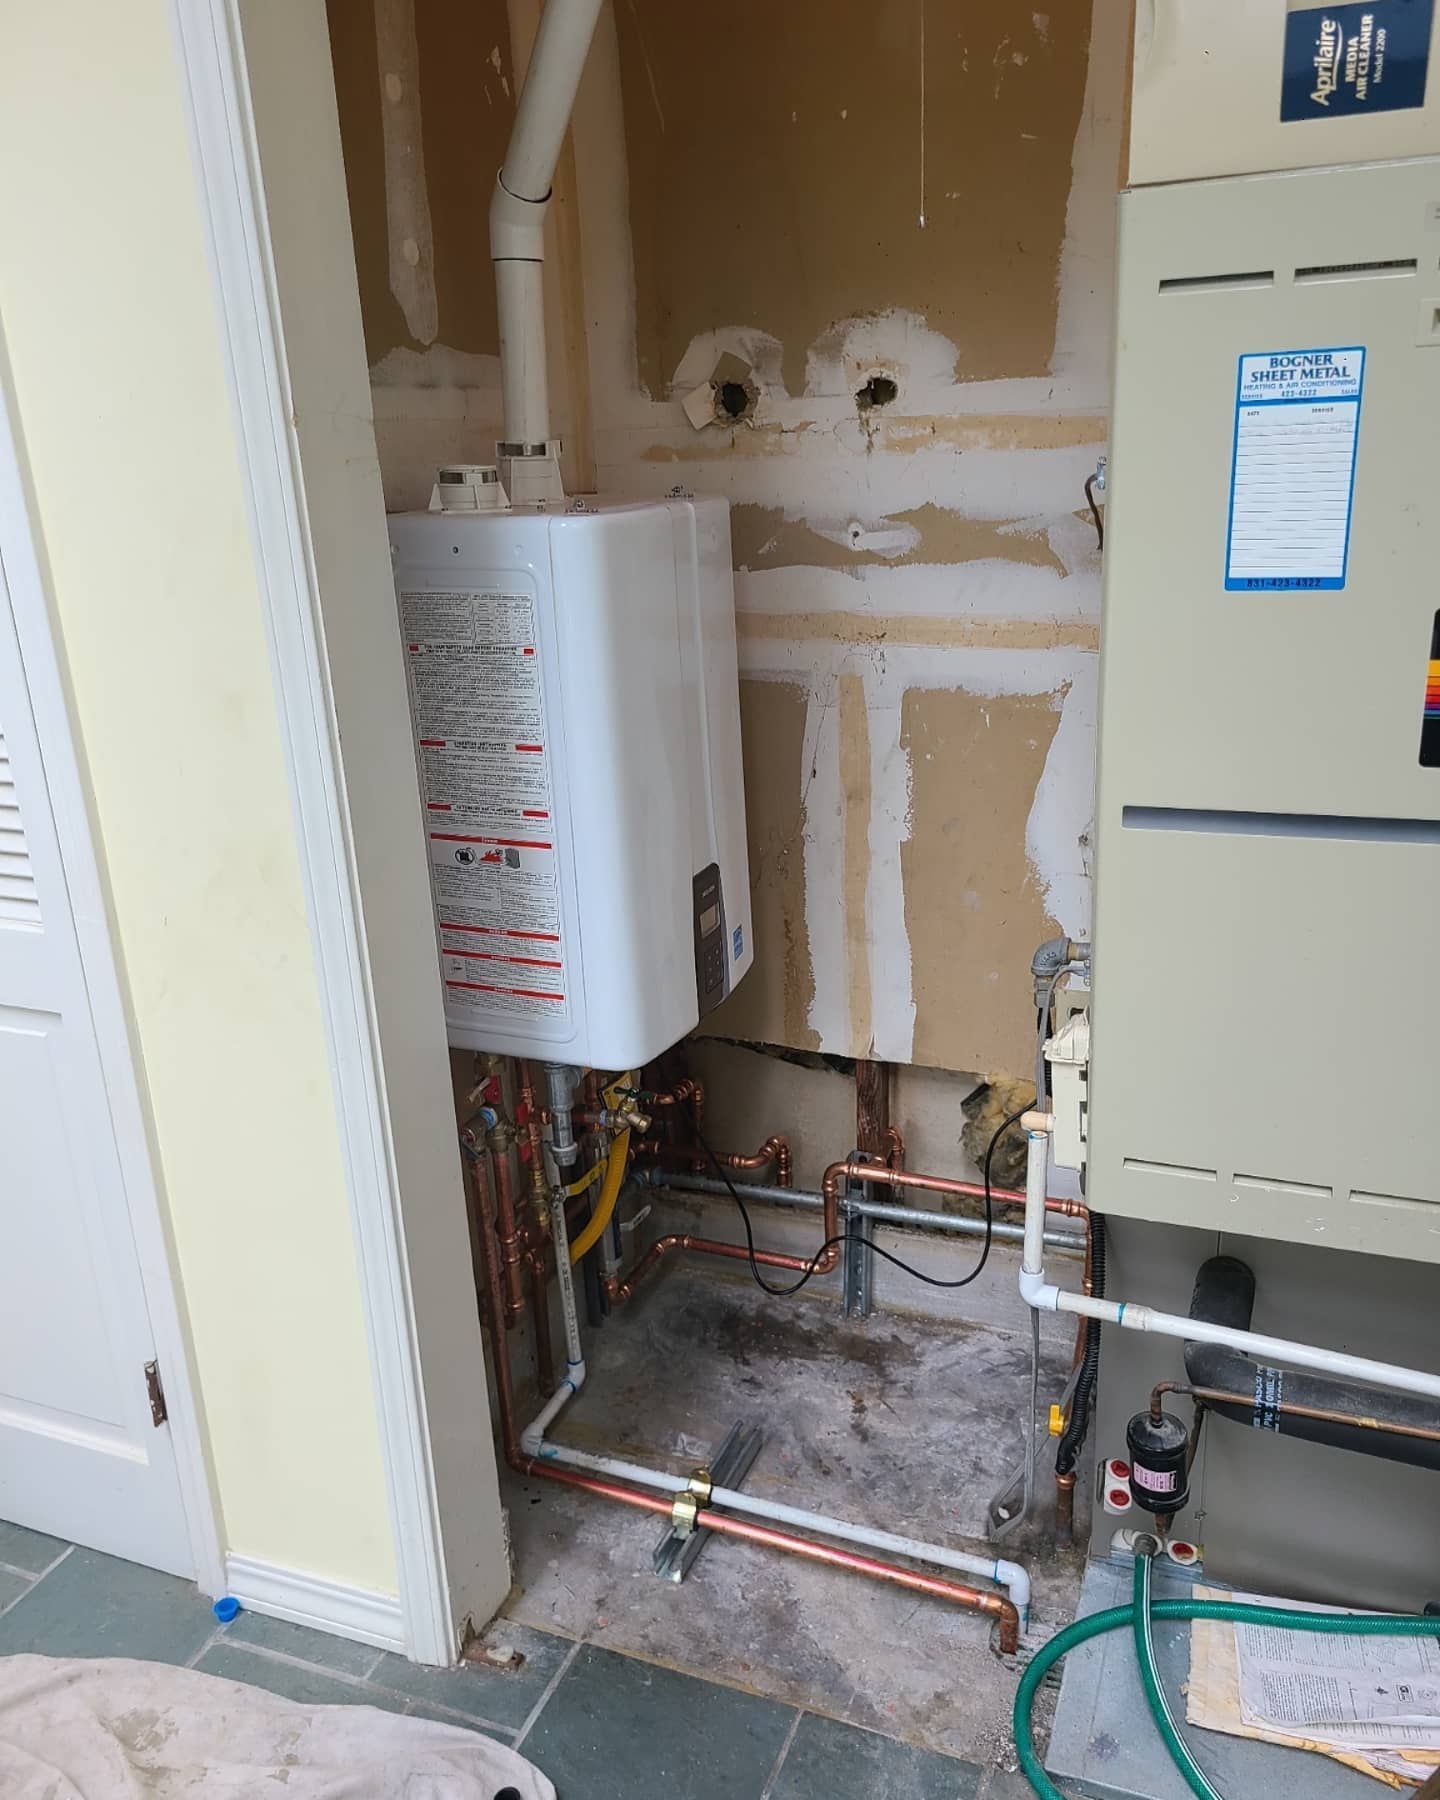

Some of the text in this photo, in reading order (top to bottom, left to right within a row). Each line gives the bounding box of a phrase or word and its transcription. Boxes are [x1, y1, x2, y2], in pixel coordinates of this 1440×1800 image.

[1310, 19, 1337, 106] Aprilaire
[1345, 36, 1360, 83] MEDIA
[1355, 13, 1374, 101] AIR CLEANER
[1373, 54, 1384, 84] Model
[1251, 366, 1351, 383] SHEET METAL
[1269, 354, 1334, 369] BOGNER
[1243, 382, 1277, 391] HEATING
[1285, 381, 1299, 389] AIR
[1300, 378, 1357, 388] CONDITIONING
